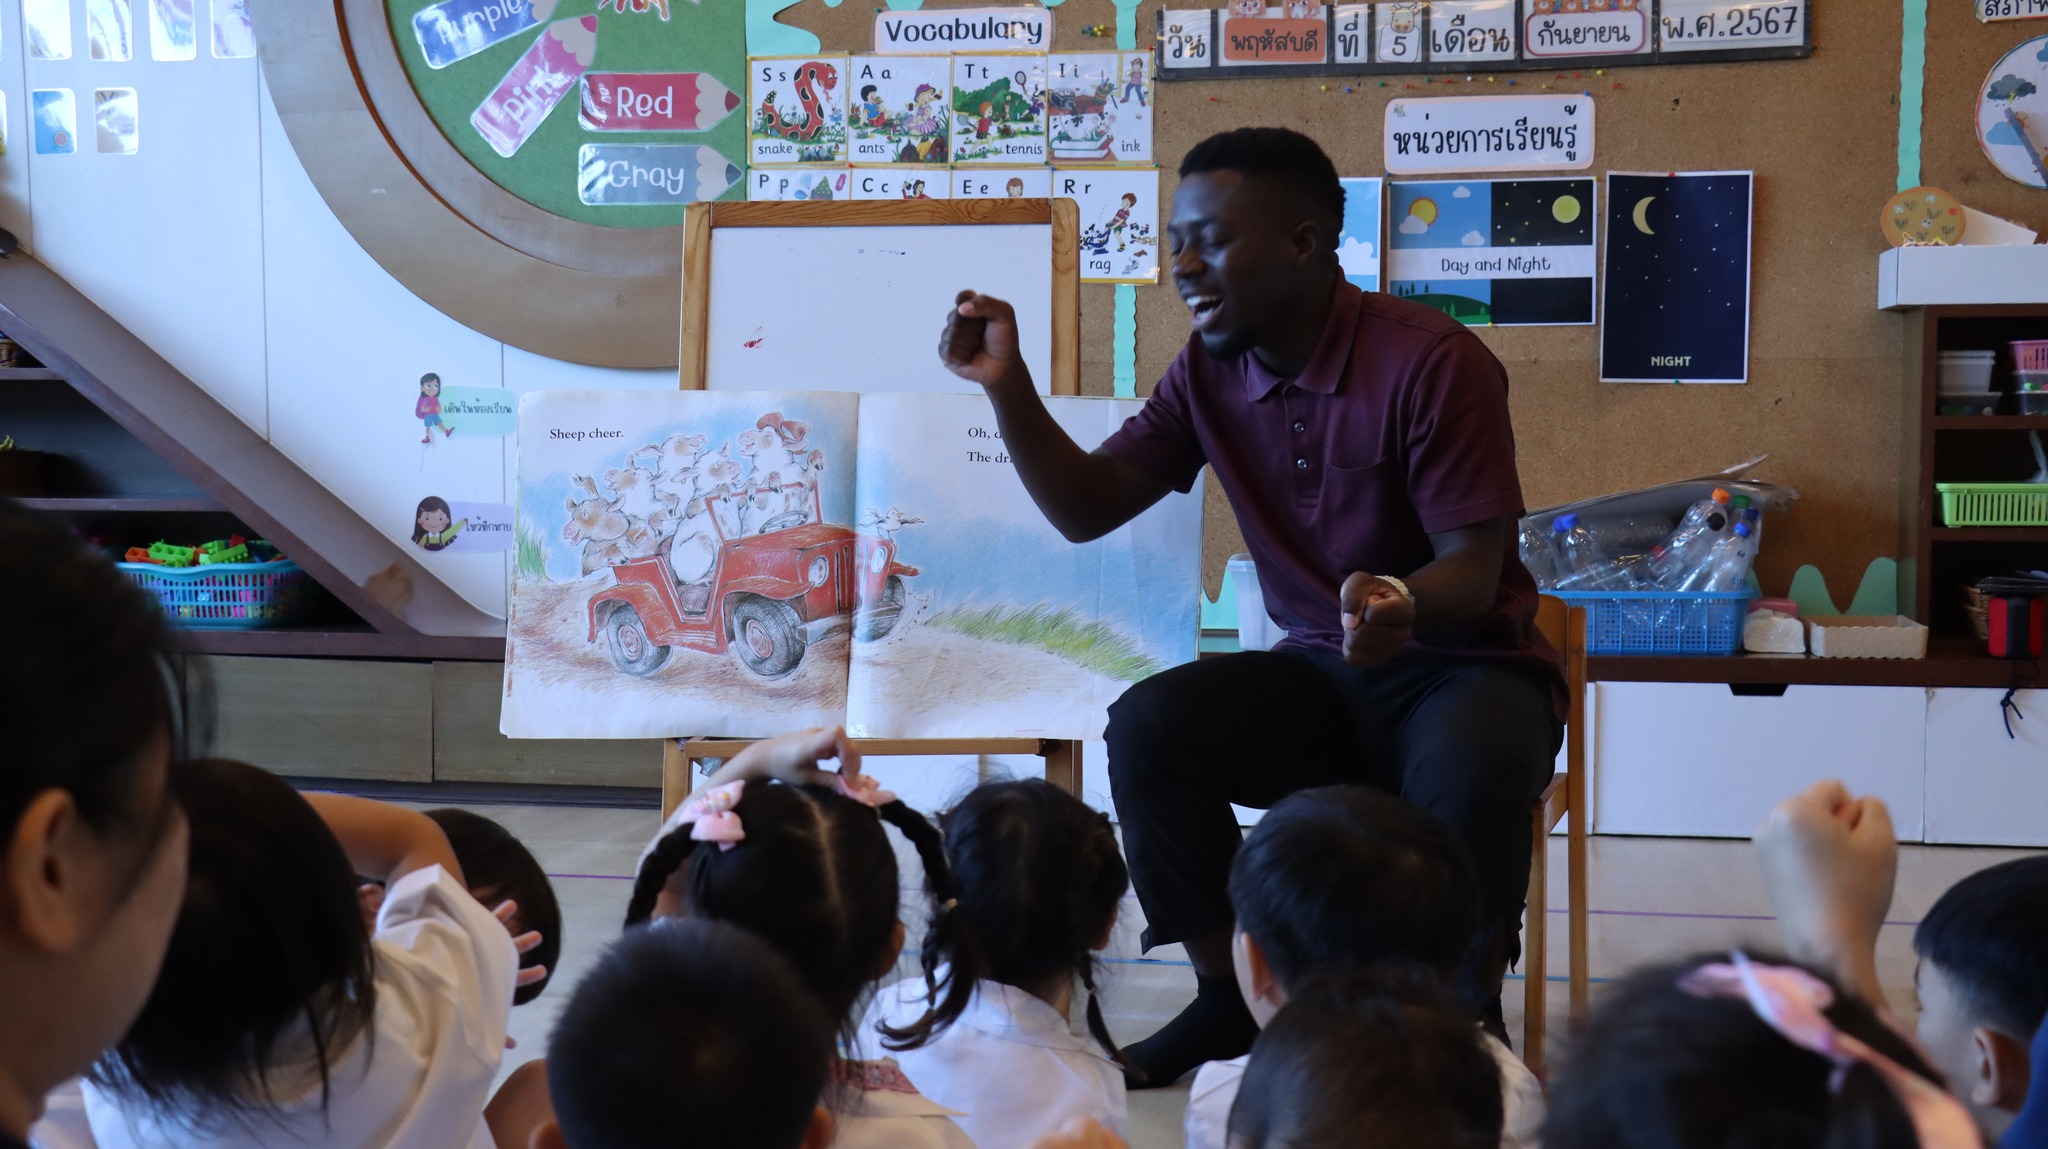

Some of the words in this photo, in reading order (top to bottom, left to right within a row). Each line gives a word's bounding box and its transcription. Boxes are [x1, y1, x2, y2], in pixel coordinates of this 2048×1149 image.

[885, 16, 1043, 45] Vocabulary
[1168, 24, 1206, 59] วัน
[1231, 26, 1318, 58] พฤหัสบดี
[1338, 11, 1359, 57] ที่
[1391, 36, 1407, 56] 5
[1432, 14, 1510, 53] เดือน
[1537, 20, 1631, 46] กันยายน
[1662, 6, 1798, 39] พ.ศ.2567
[503, 62, 561, 128] Pink
[616, 86, 673, 119] Red
[1393, 104, 1577, 161] หน่วยการเรียนรู้
[757, 142, 793, 156] snake
[858, 143, 885, 154] ants
[1005, 142, 1043, 155] tennis
[1121, 139, 1142, 152] ink
[608, 160, 685, 195] Gray
[1089, 259, 1111, 274] rag
[1441, 258, 1469, 275] Day
[1474, 257, 1501, 272] and
[1507, 256, 1551, 275] Night
[1651, 355, 1692, 367] NIGHT
[549, 428, 586, 442] Sheep
[588, 428, 624, 439] cheer.
[967, 427, 991, 440] Oh,
[966, 451, 992, 463] The
